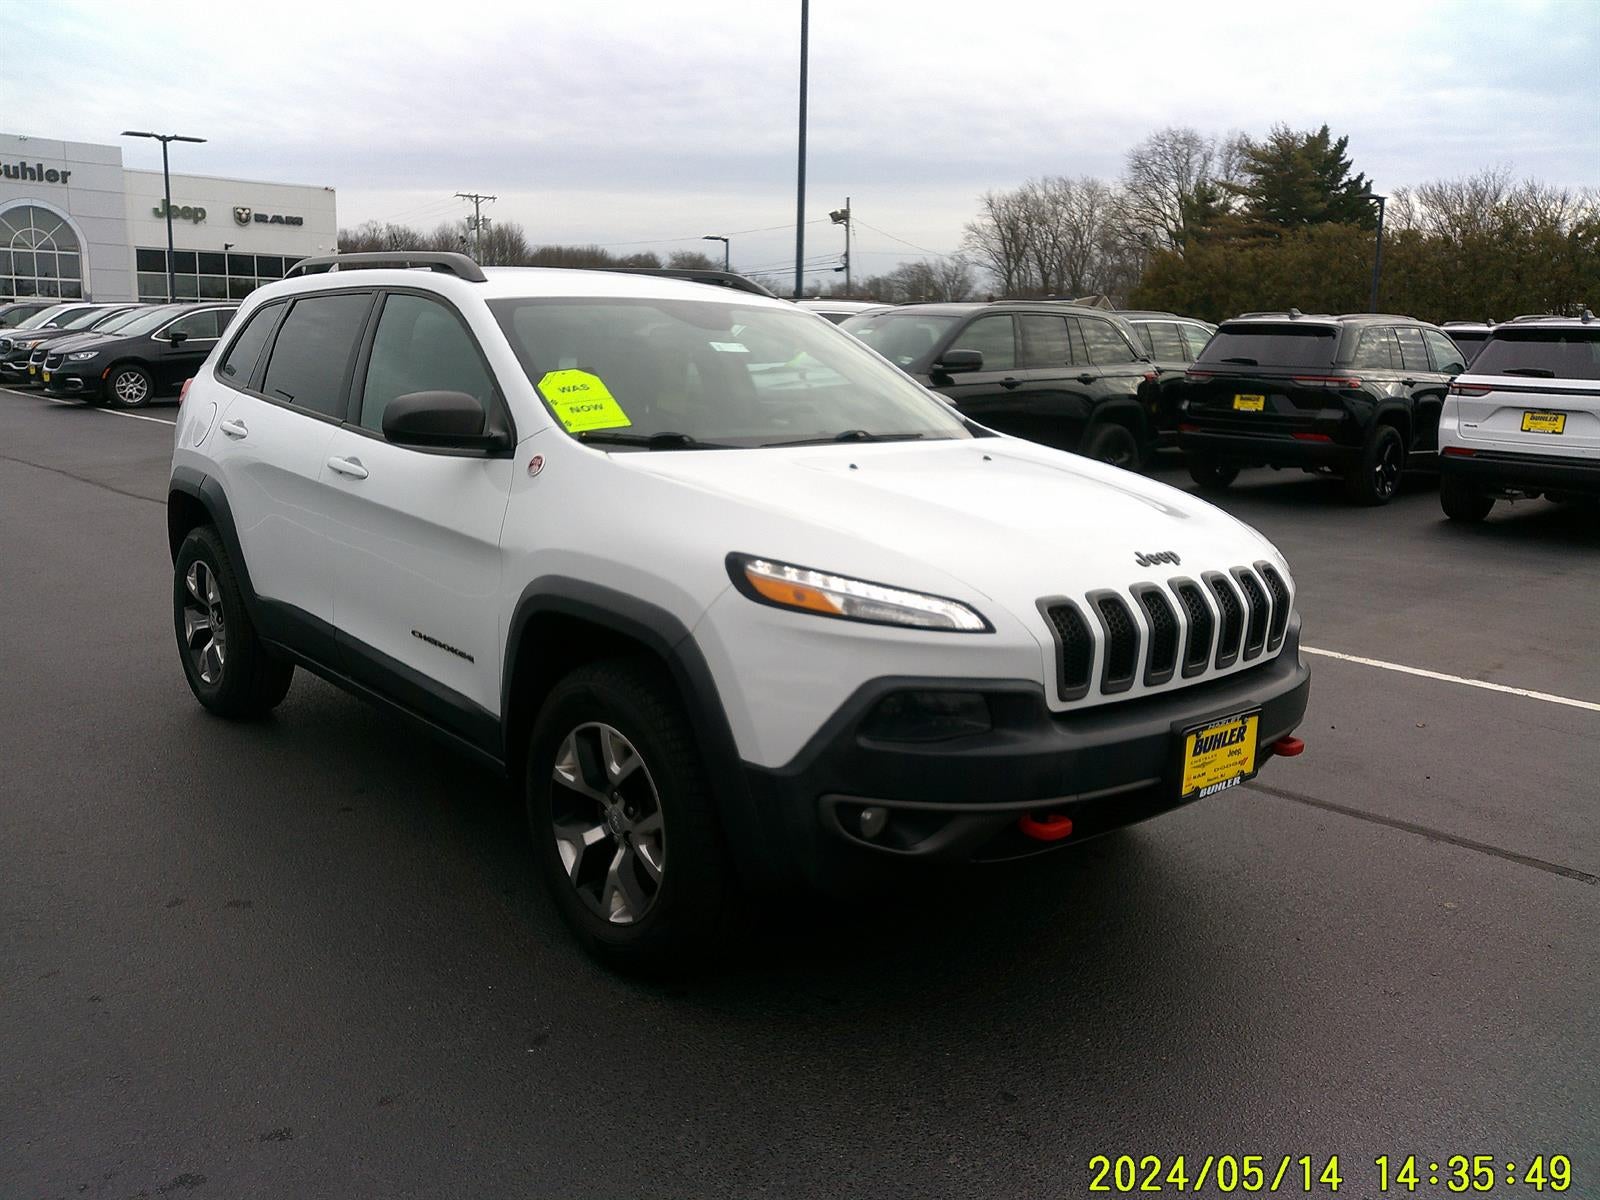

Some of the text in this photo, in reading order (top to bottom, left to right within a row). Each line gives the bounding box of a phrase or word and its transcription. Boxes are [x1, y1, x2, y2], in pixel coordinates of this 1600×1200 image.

[0, 160, 72, 184] uhler
[152, 199, 207, 224] Jeep
[254, 213, 303, 226] RAM
[558, 383, 590, 393] WAS
[569, 403, 604, 414] NOW
[1134, 550, 1181, 568] Jeep
[411, 630, 475, 664] CHEROKEE
[1192, 725, 1248, 757] BUHLER
[1227, 747, 1242, 758] Jeep
[1200, 776, 1241, 798] BUHLER
